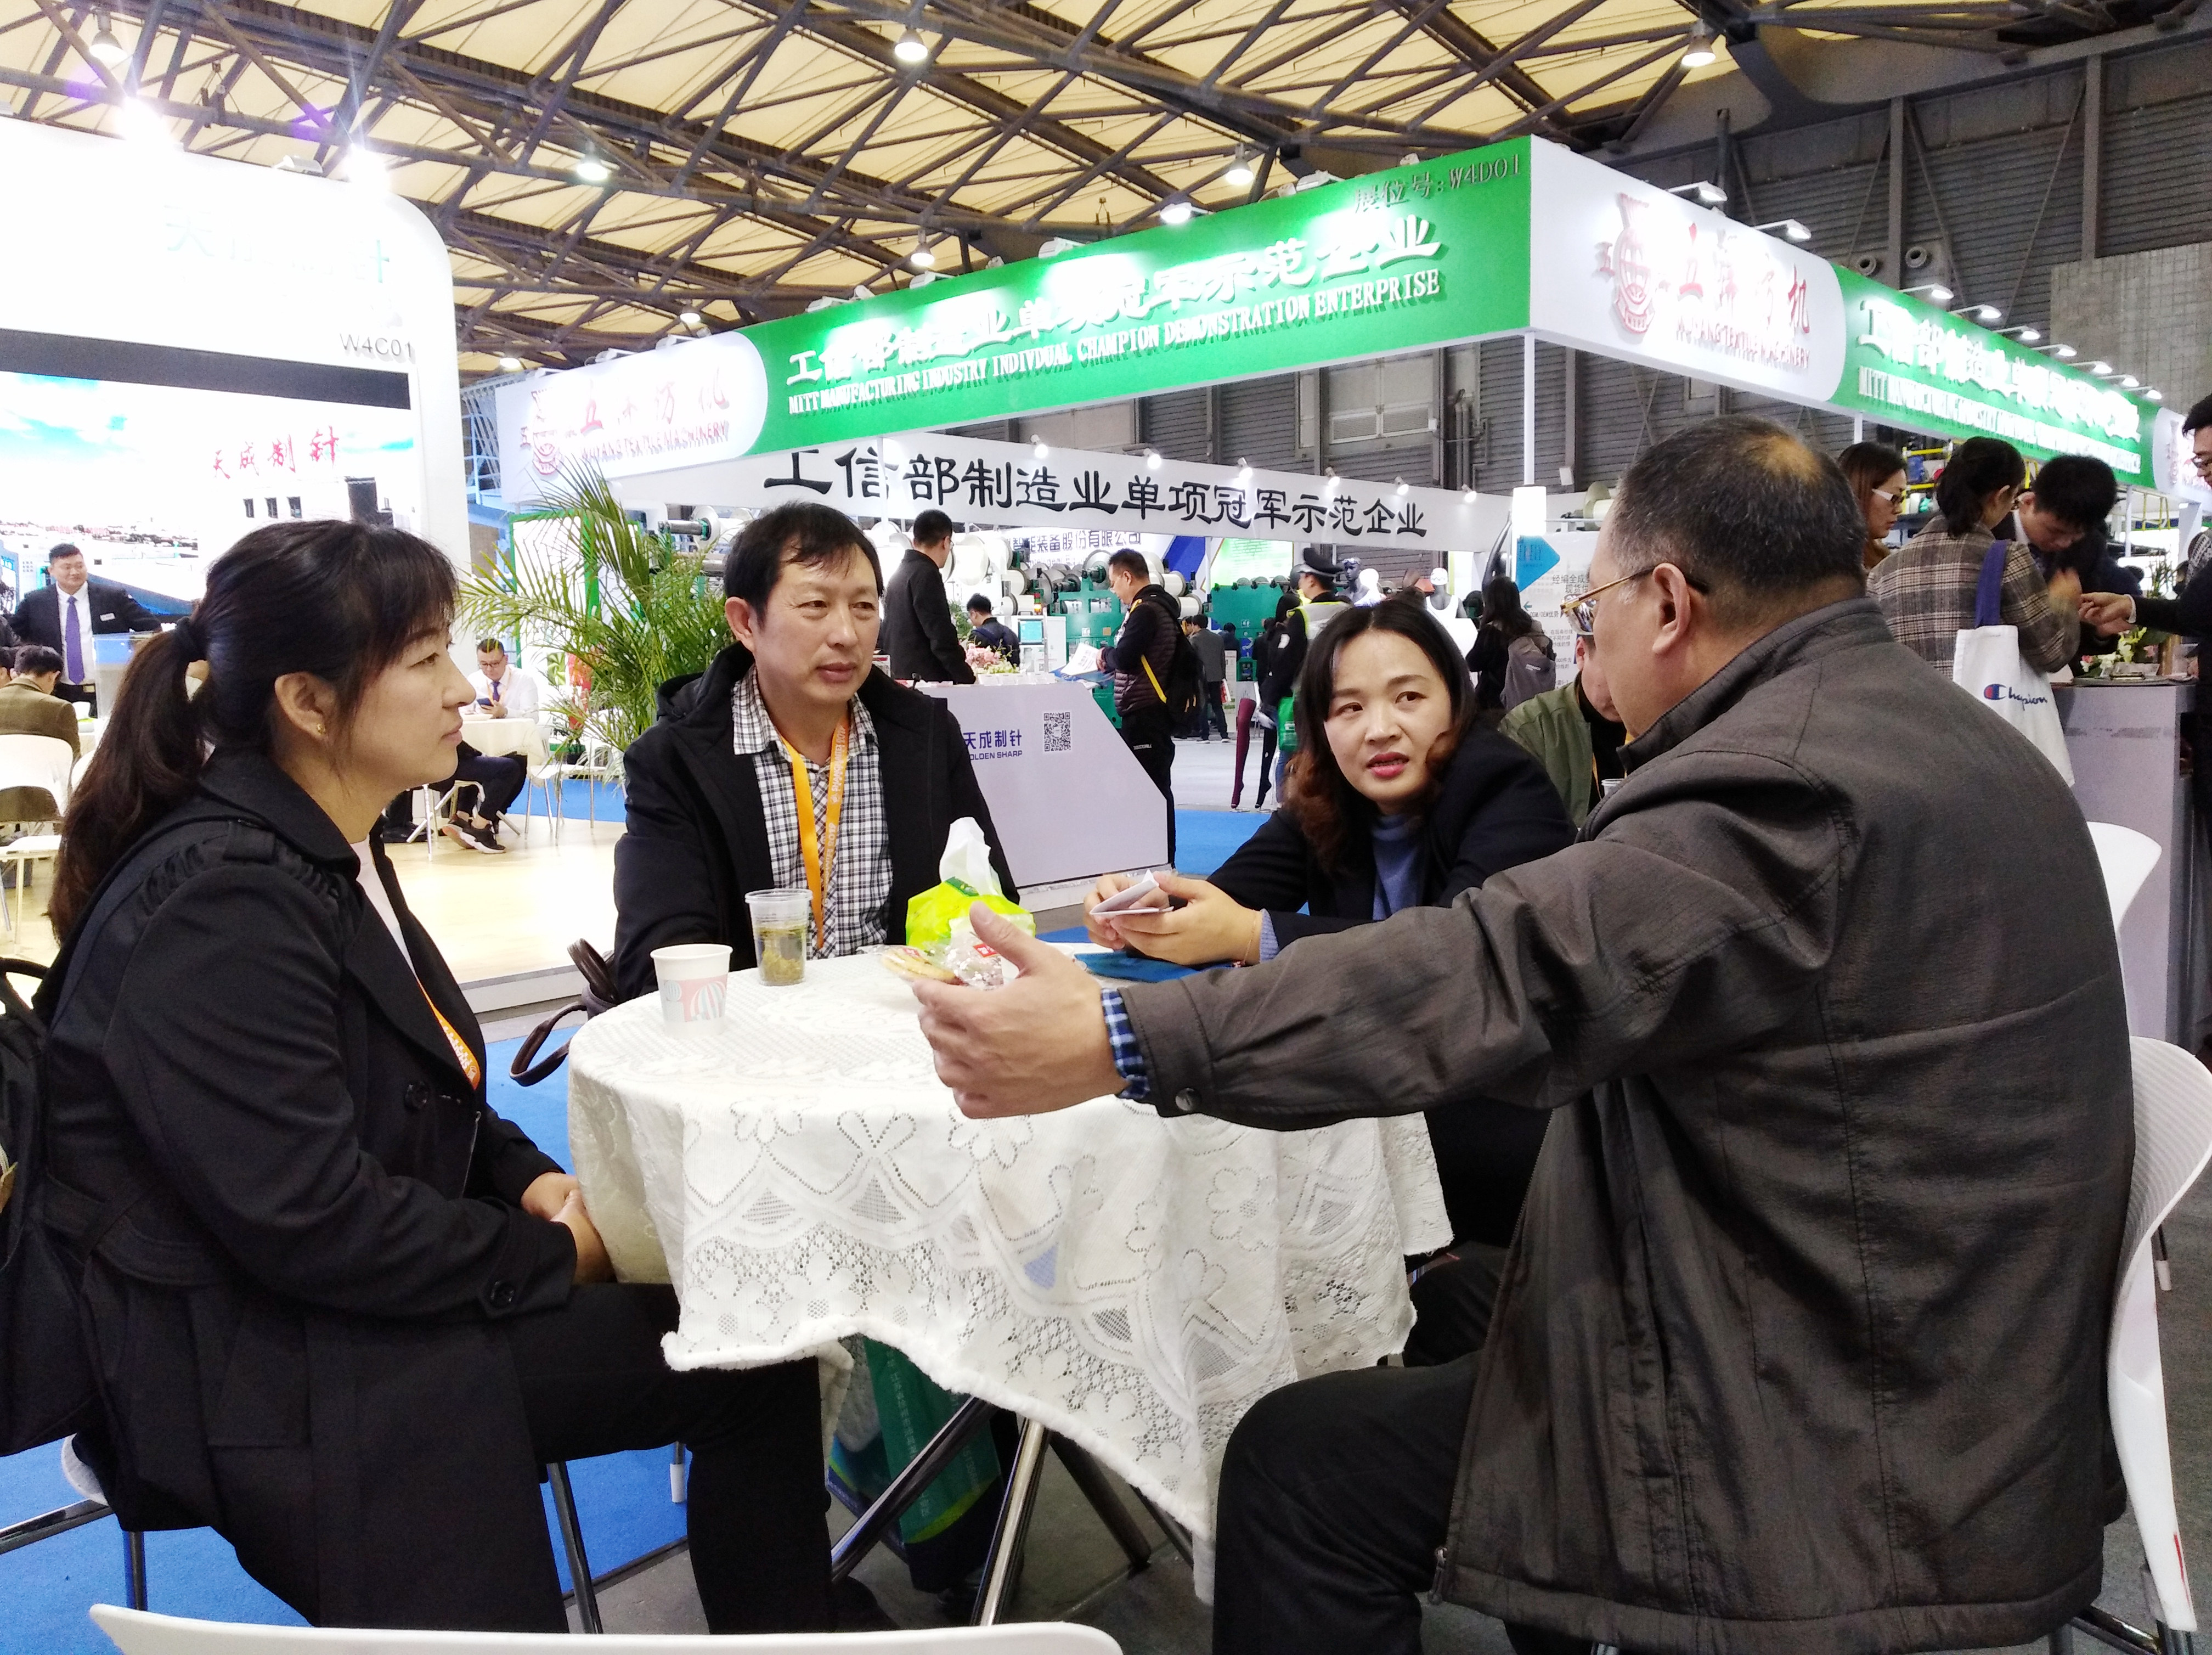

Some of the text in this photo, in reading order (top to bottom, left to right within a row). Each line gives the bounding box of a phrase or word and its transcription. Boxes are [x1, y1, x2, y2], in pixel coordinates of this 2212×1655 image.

[340, 333, 411, 357] W4C01
[821, 371, 919, 408] MANUFACTURING
[922, 358, 988, 390] INDUSTRY
[1077, 325, 1159, 361] CHAMPION
[1164, 295, 1310, 345] DEMONSTRATION
[1315, 269, 1440, 317] ENTERPRISE
[764, 447, 1427, 538] 工信部制造业单项冠军示范企业
[963, 729, 1022, 749] 天成制针
[970, 750, 1023, 761] OLDEN SHARP
